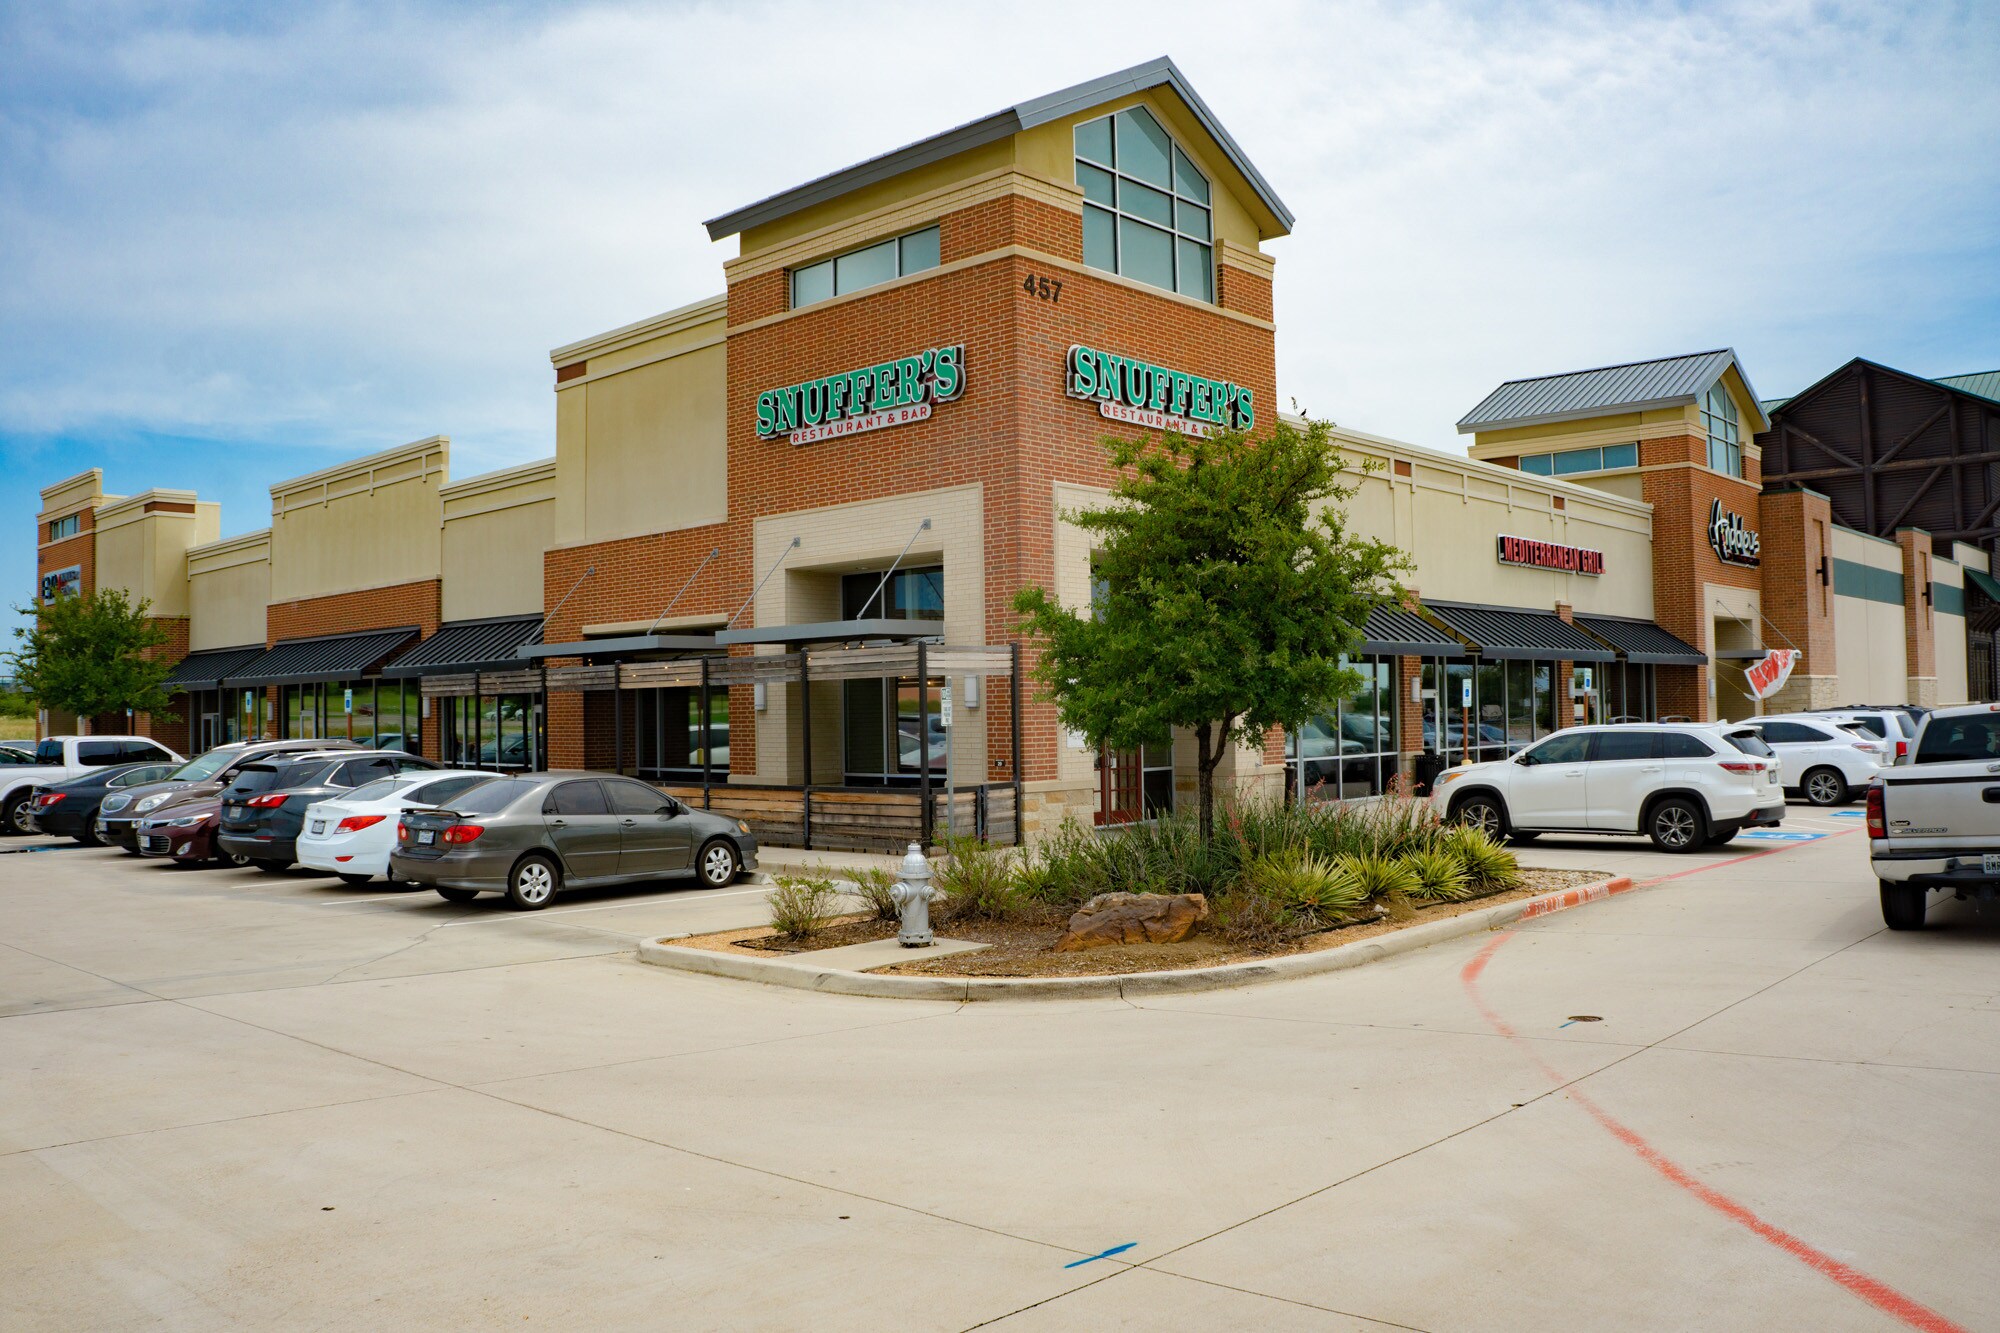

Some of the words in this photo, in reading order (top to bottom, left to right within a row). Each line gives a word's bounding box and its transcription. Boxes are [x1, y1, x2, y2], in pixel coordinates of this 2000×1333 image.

[1024, 274, 1062, 302] 457
[756, 346, 960, 435] SNUFFER'S
[1074, 345, 1255, 431] SNUFFER'S
[793, 414, 883, 443] RESTAURANT
[887, 413, 896, 424] &
[901, 405, 928, 421] BAR
[1103, 403, 1188, 432] RESTAURANT
[1191, 423, 1199, 434] &
[1504, 535, 1580, 570] MEDITERRANEAN
[1582, 549, 1606, 574] GRILL
